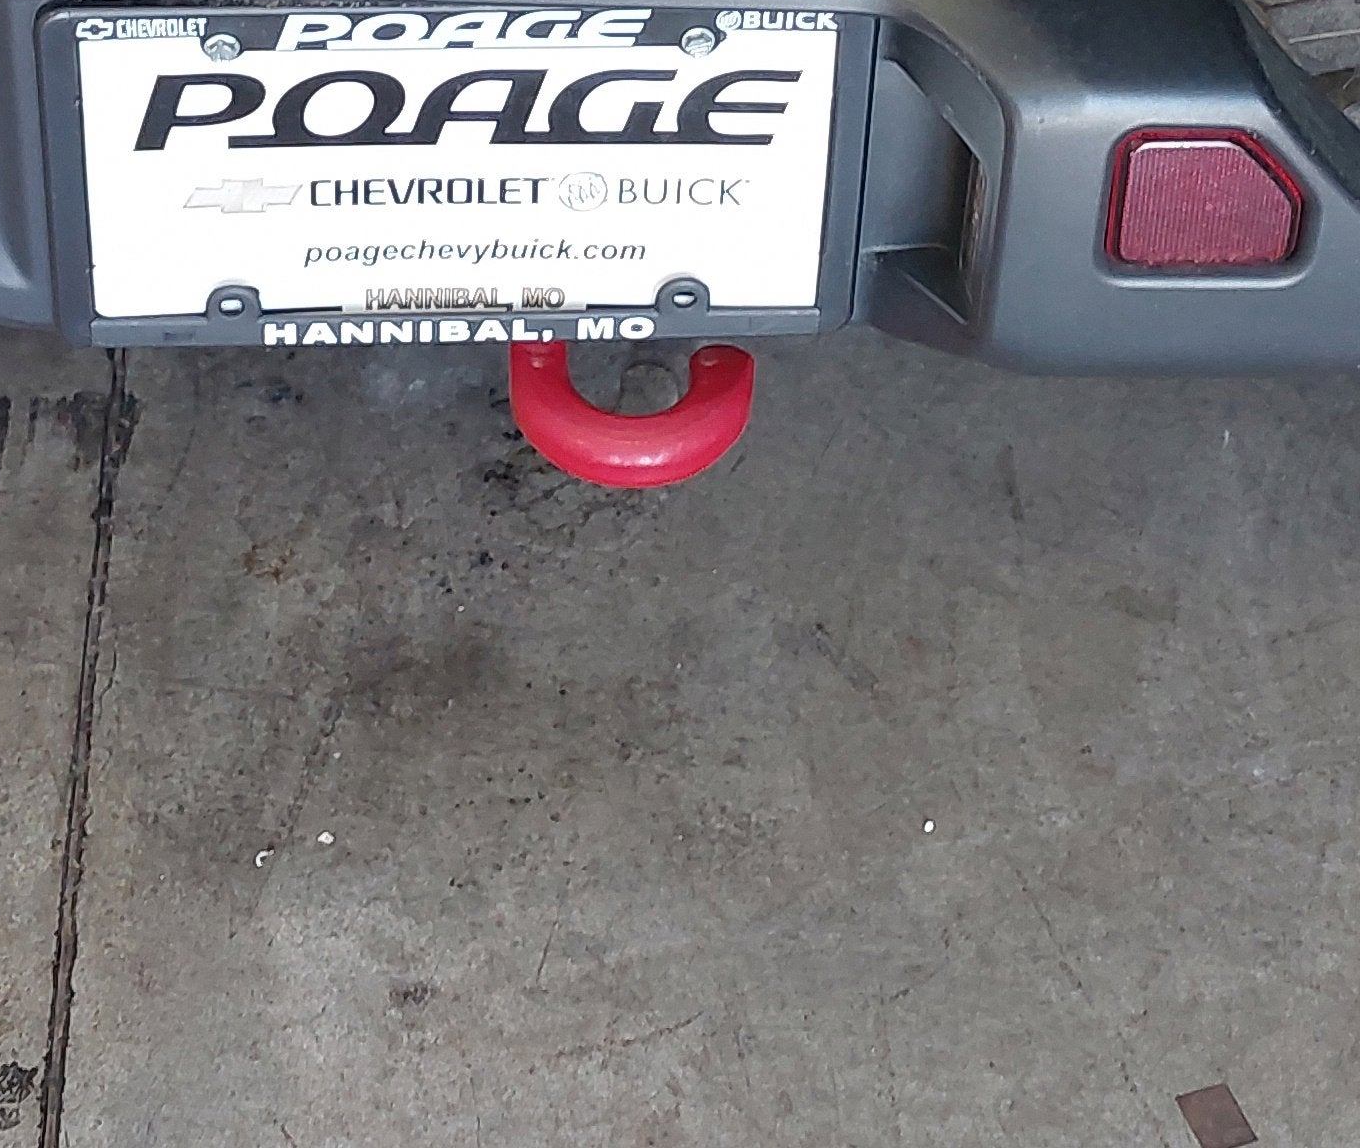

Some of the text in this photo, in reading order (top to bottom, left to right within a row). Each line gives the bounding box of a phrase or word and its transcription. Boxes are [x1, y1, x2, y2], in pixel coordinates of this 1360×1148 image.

[116, 18, 208, 39] CHEVROLET
[276, 9, 653, 51] POAGE
[742, 11, 839, 30] BUICK
[134, 68, 802, 151] POAGE
[309, 178, 742, 207] CHEVROLET BUICK
[304, 238, 646, 268] poagechevybuick.com
[521, 287, 565, 309] MO
[264, 317, 656, 346] HANNIBAL, MO
